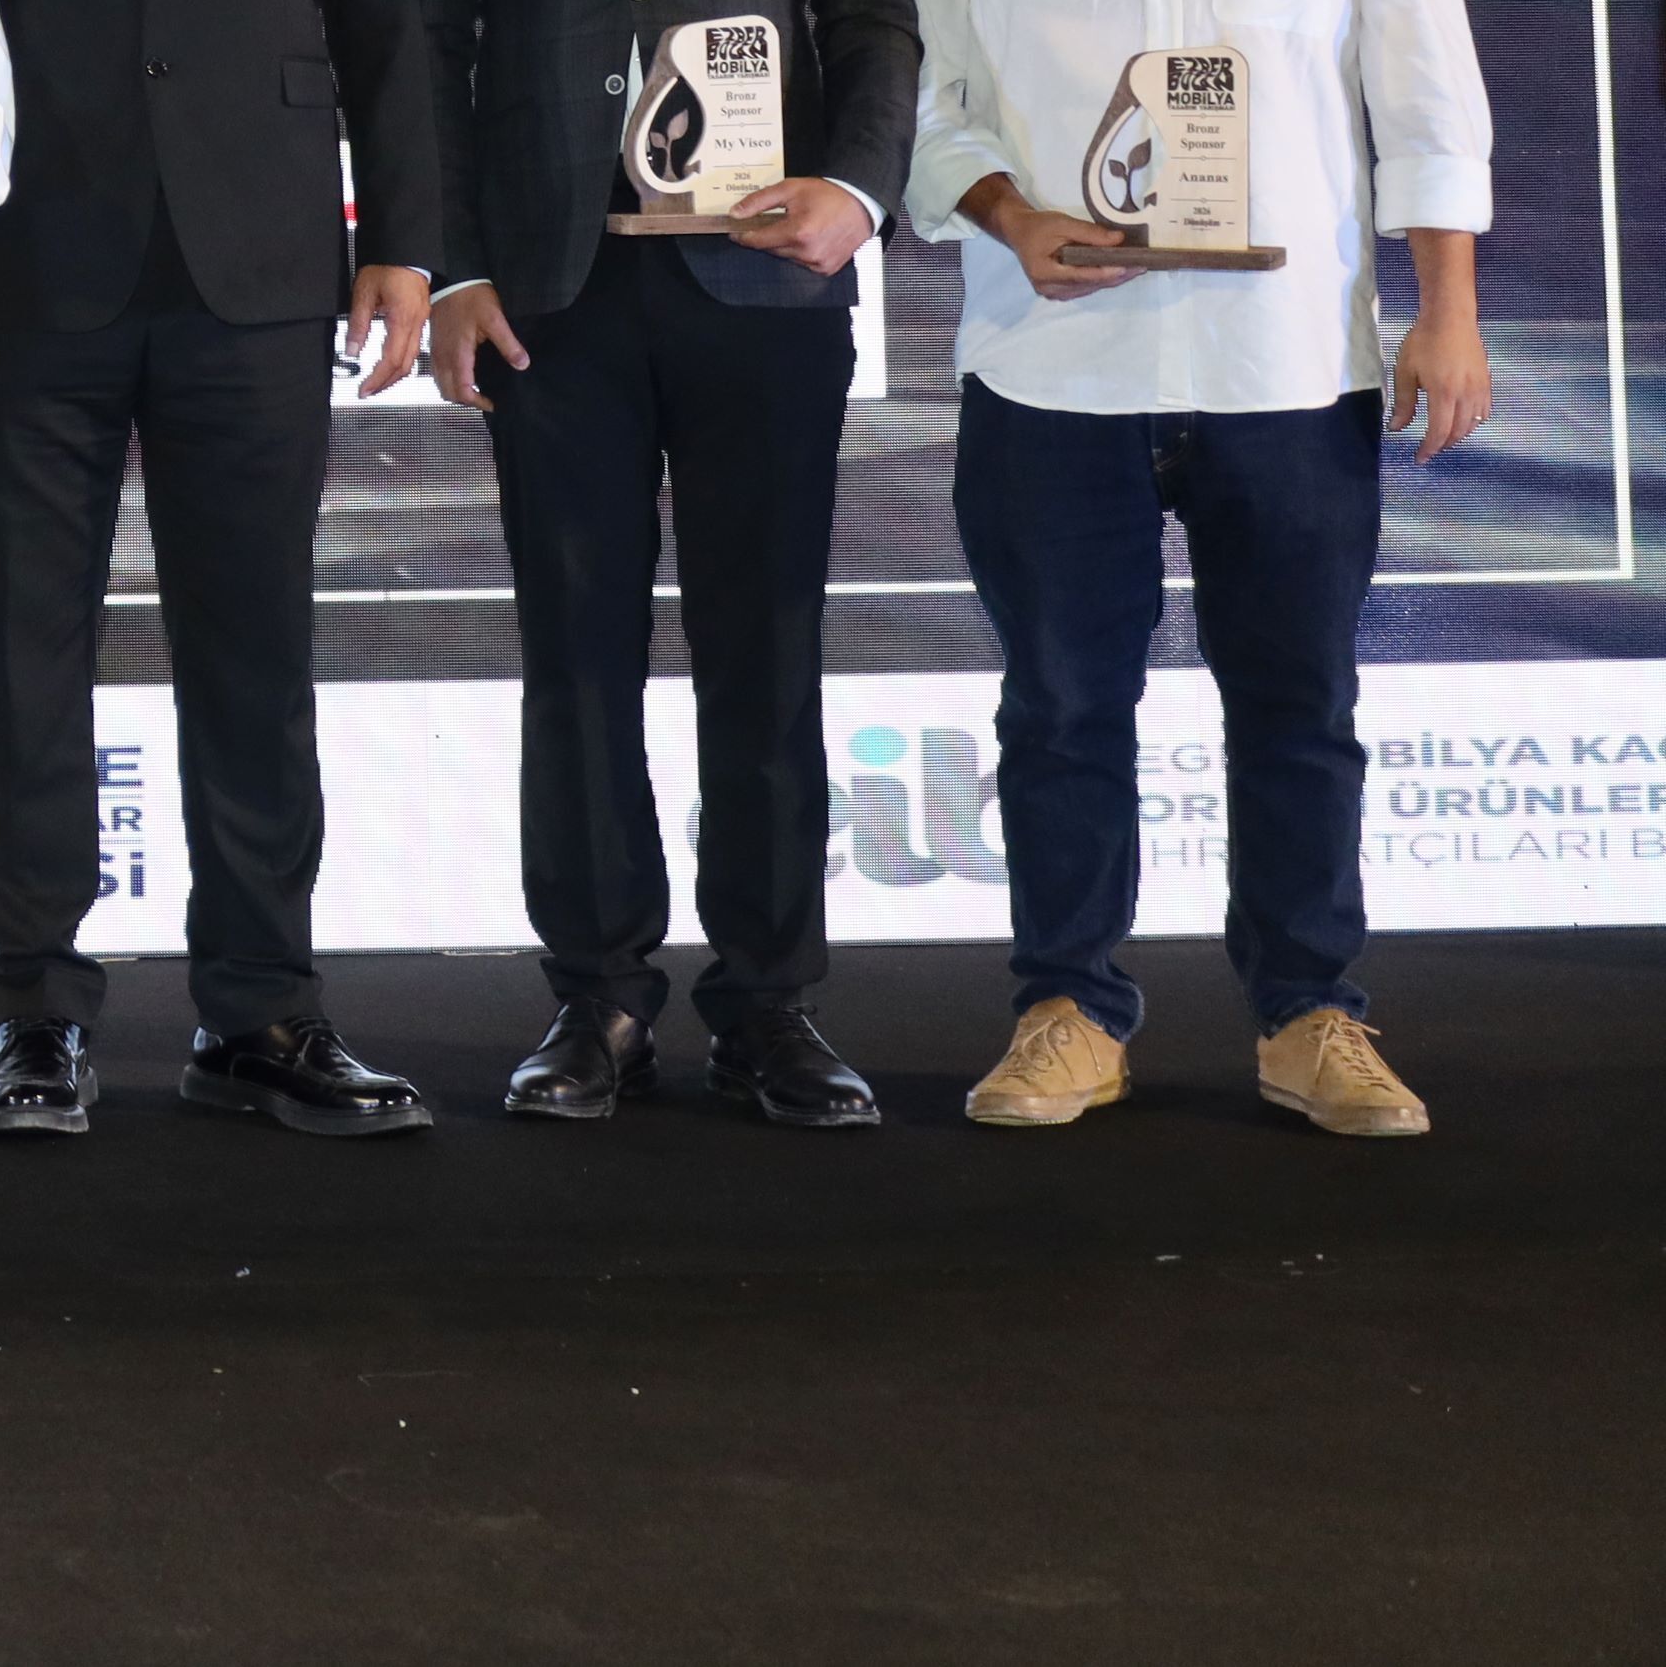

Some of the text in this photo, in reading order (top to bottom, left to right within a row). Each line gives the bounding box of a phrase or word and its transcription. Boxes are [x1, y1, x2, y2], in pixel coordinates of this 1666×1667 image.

[725, 91, 756, 102] Bronz
[720, 106, 762, 118] Sponsor
[1186, 123, 1220, 134] Bronz
[715, 137, 772, 151] My Visco
[1180, 138, 1225, 151] Sponsor
[1179, 172, 1228, 183] Ananas
